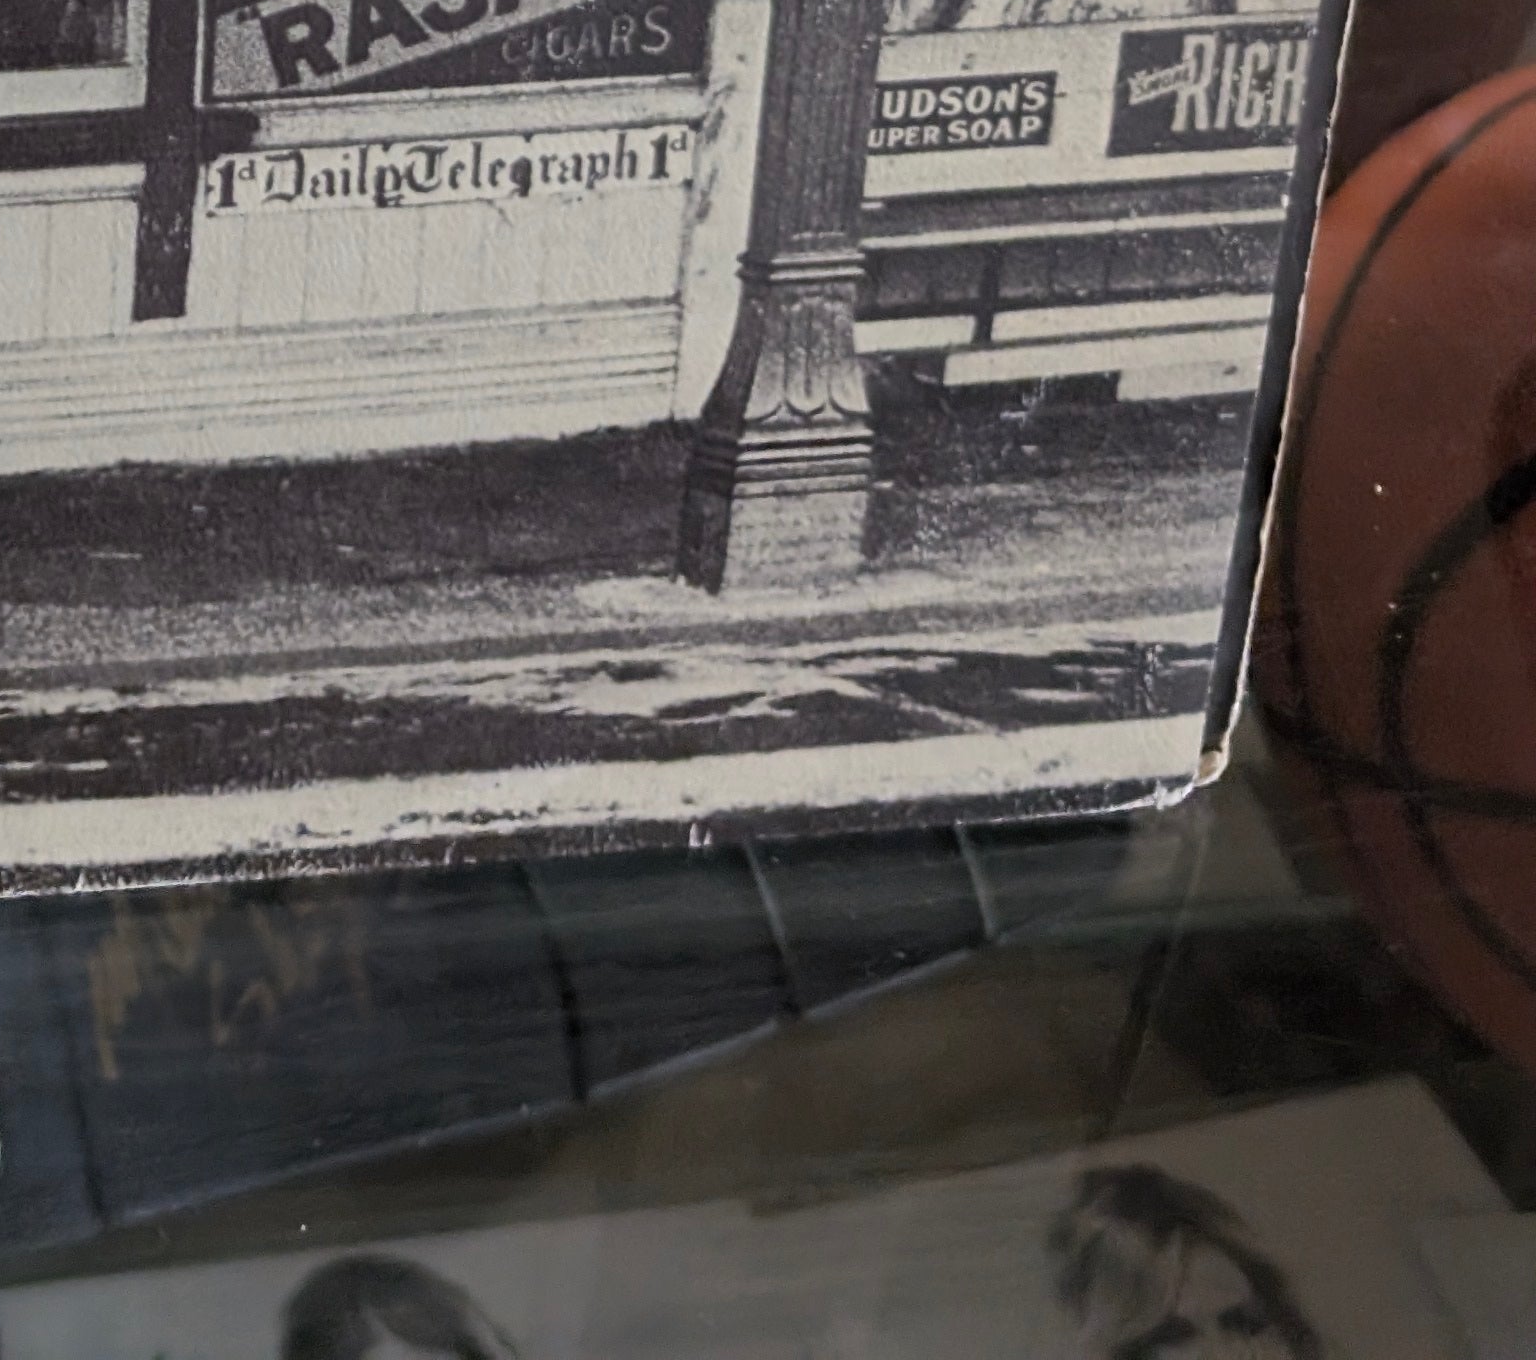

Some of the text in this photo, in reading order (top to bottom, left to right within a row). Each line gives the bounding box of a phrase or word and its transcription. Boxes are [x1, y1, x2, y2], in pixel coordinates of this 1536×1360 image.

[501, 4, 674, 66] CIGARS
[872, 78, 1048, 121] UDSON'S
[866, 115, 1043, 149] UPER SOAP
[262, 144, 405, 208] Daily
[405, 133, 639, 197] Telegraph
